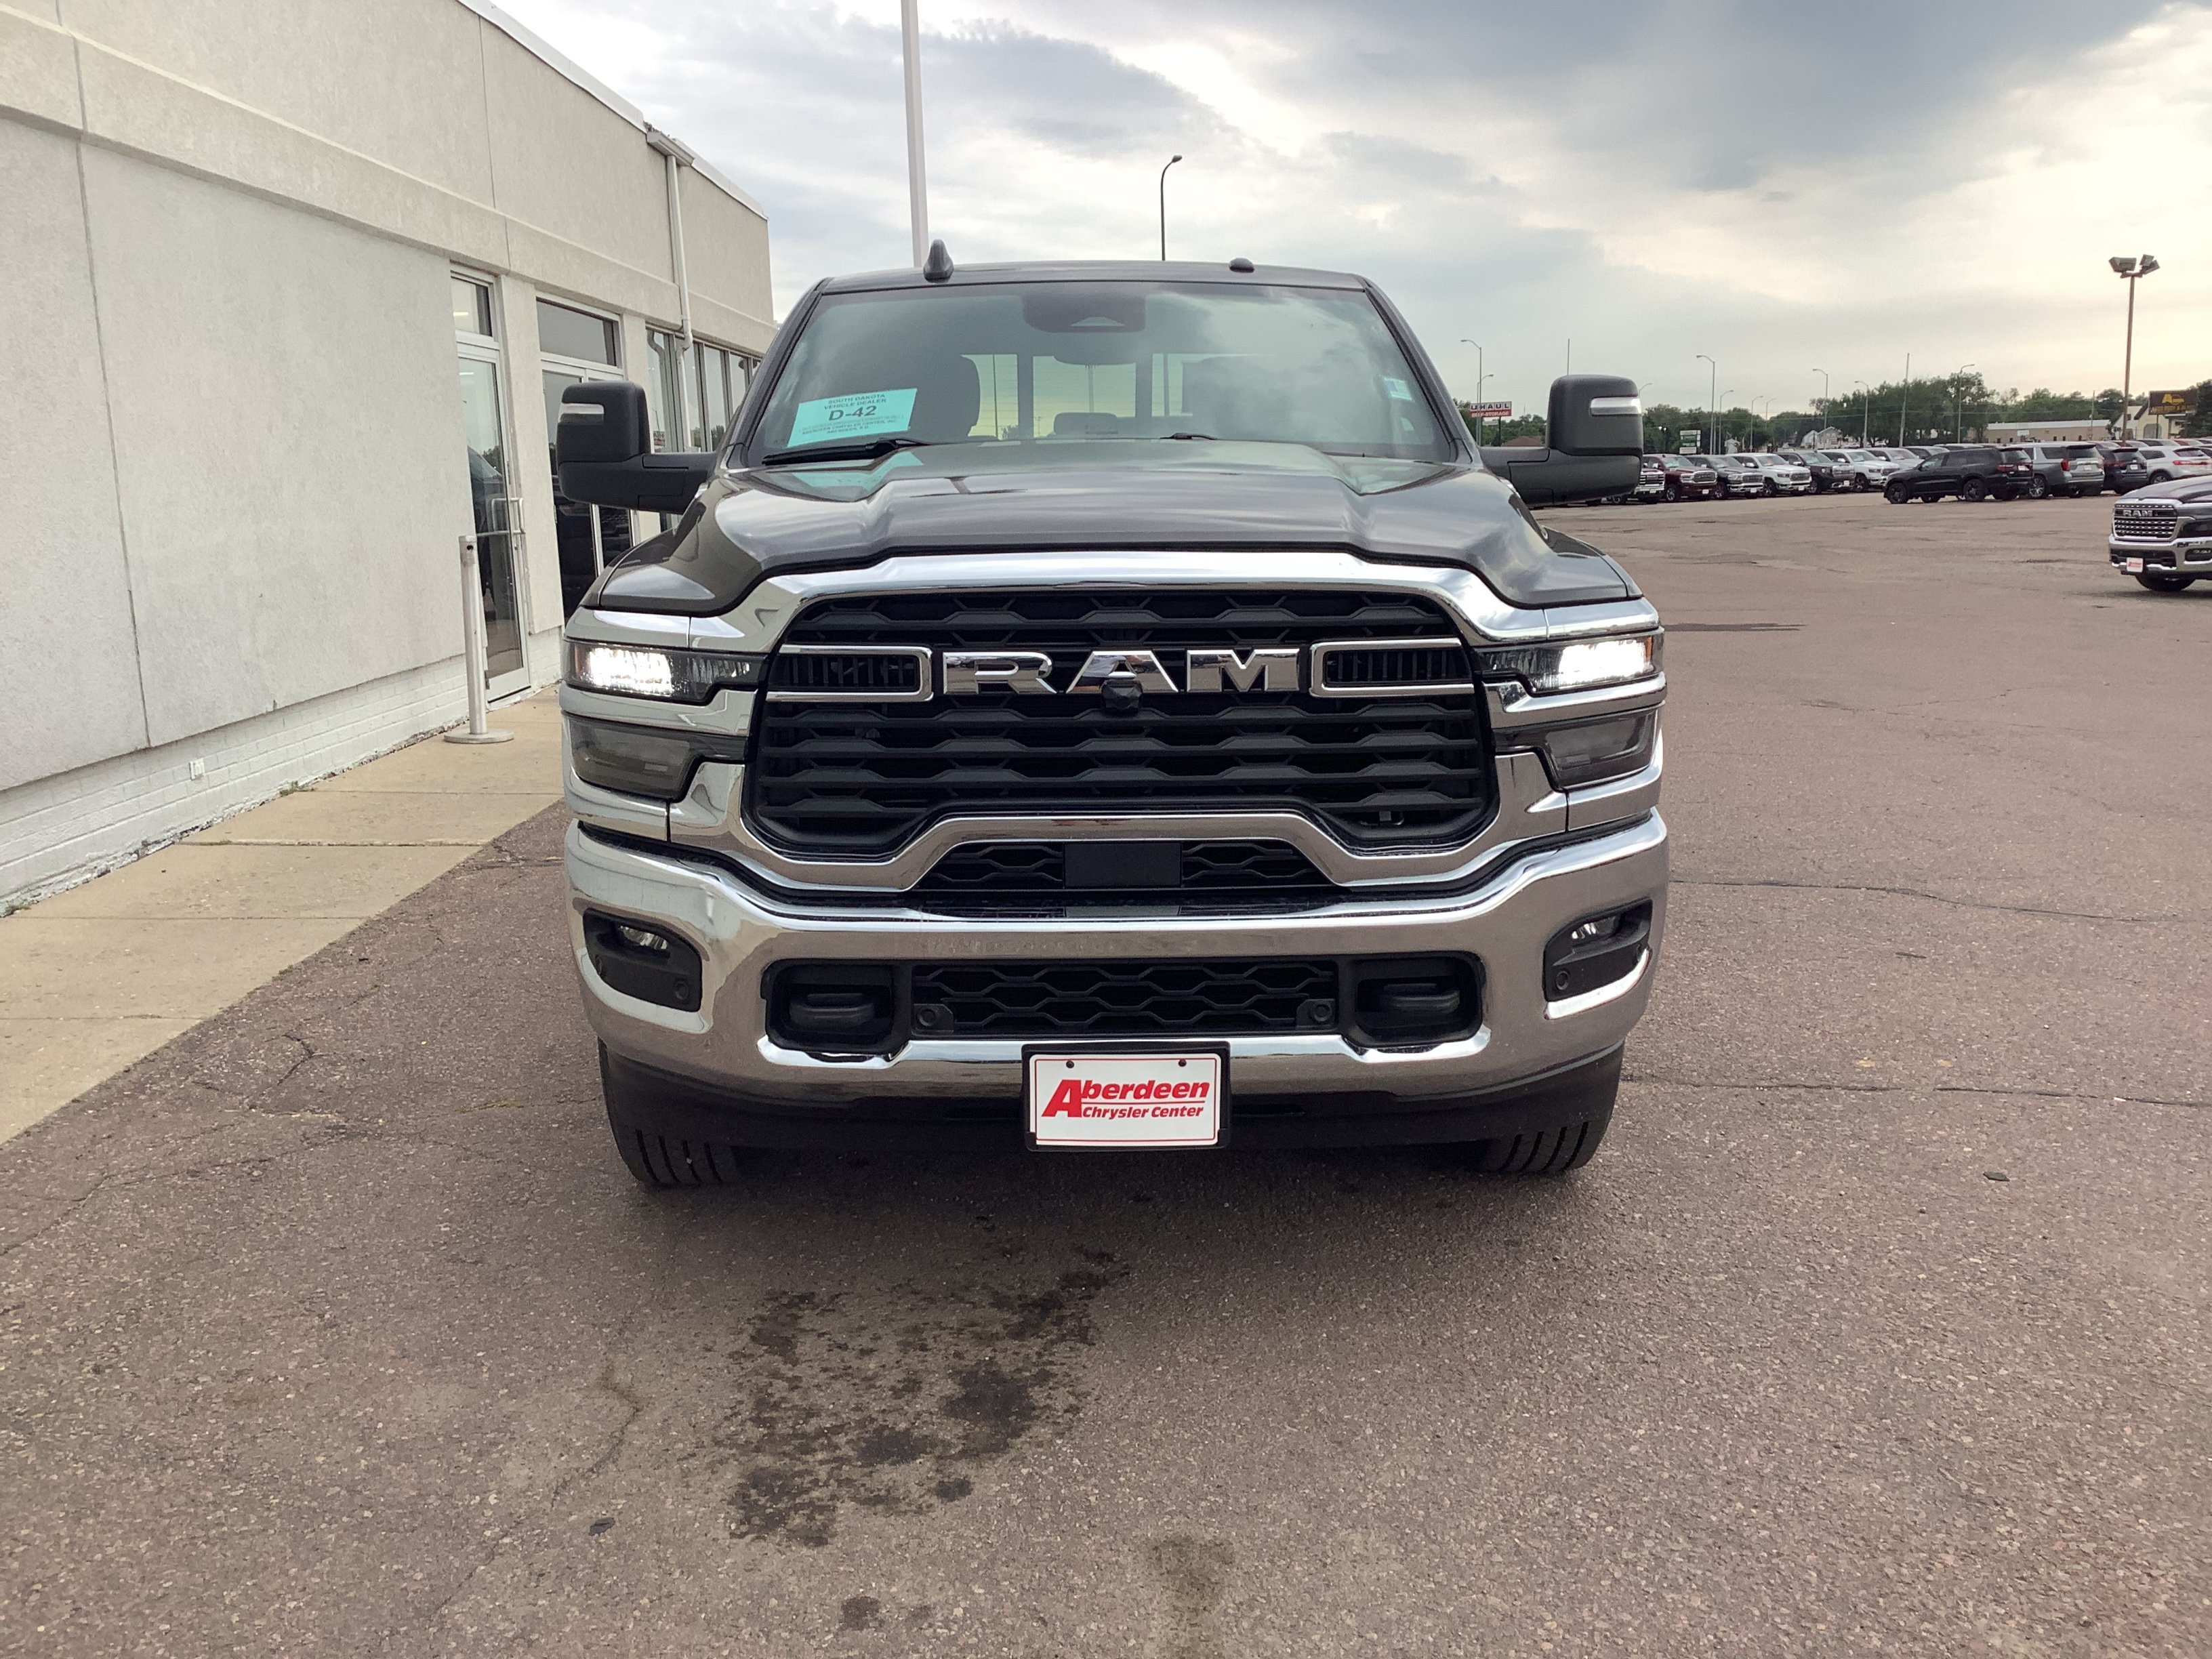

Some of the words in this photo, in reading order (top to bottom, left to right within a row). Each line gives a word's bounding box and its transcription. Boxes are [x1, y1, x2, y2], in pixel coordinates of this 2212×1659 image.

[829, 405, 877, 421] D-42
[942, 648, 1300, 694] RAM
[1041, 1079, 1210, 1118] Aberdeen
[1083, 1106, 1149, 1120] Chrysler
[1151, 1105, 1204, 1118] Center
